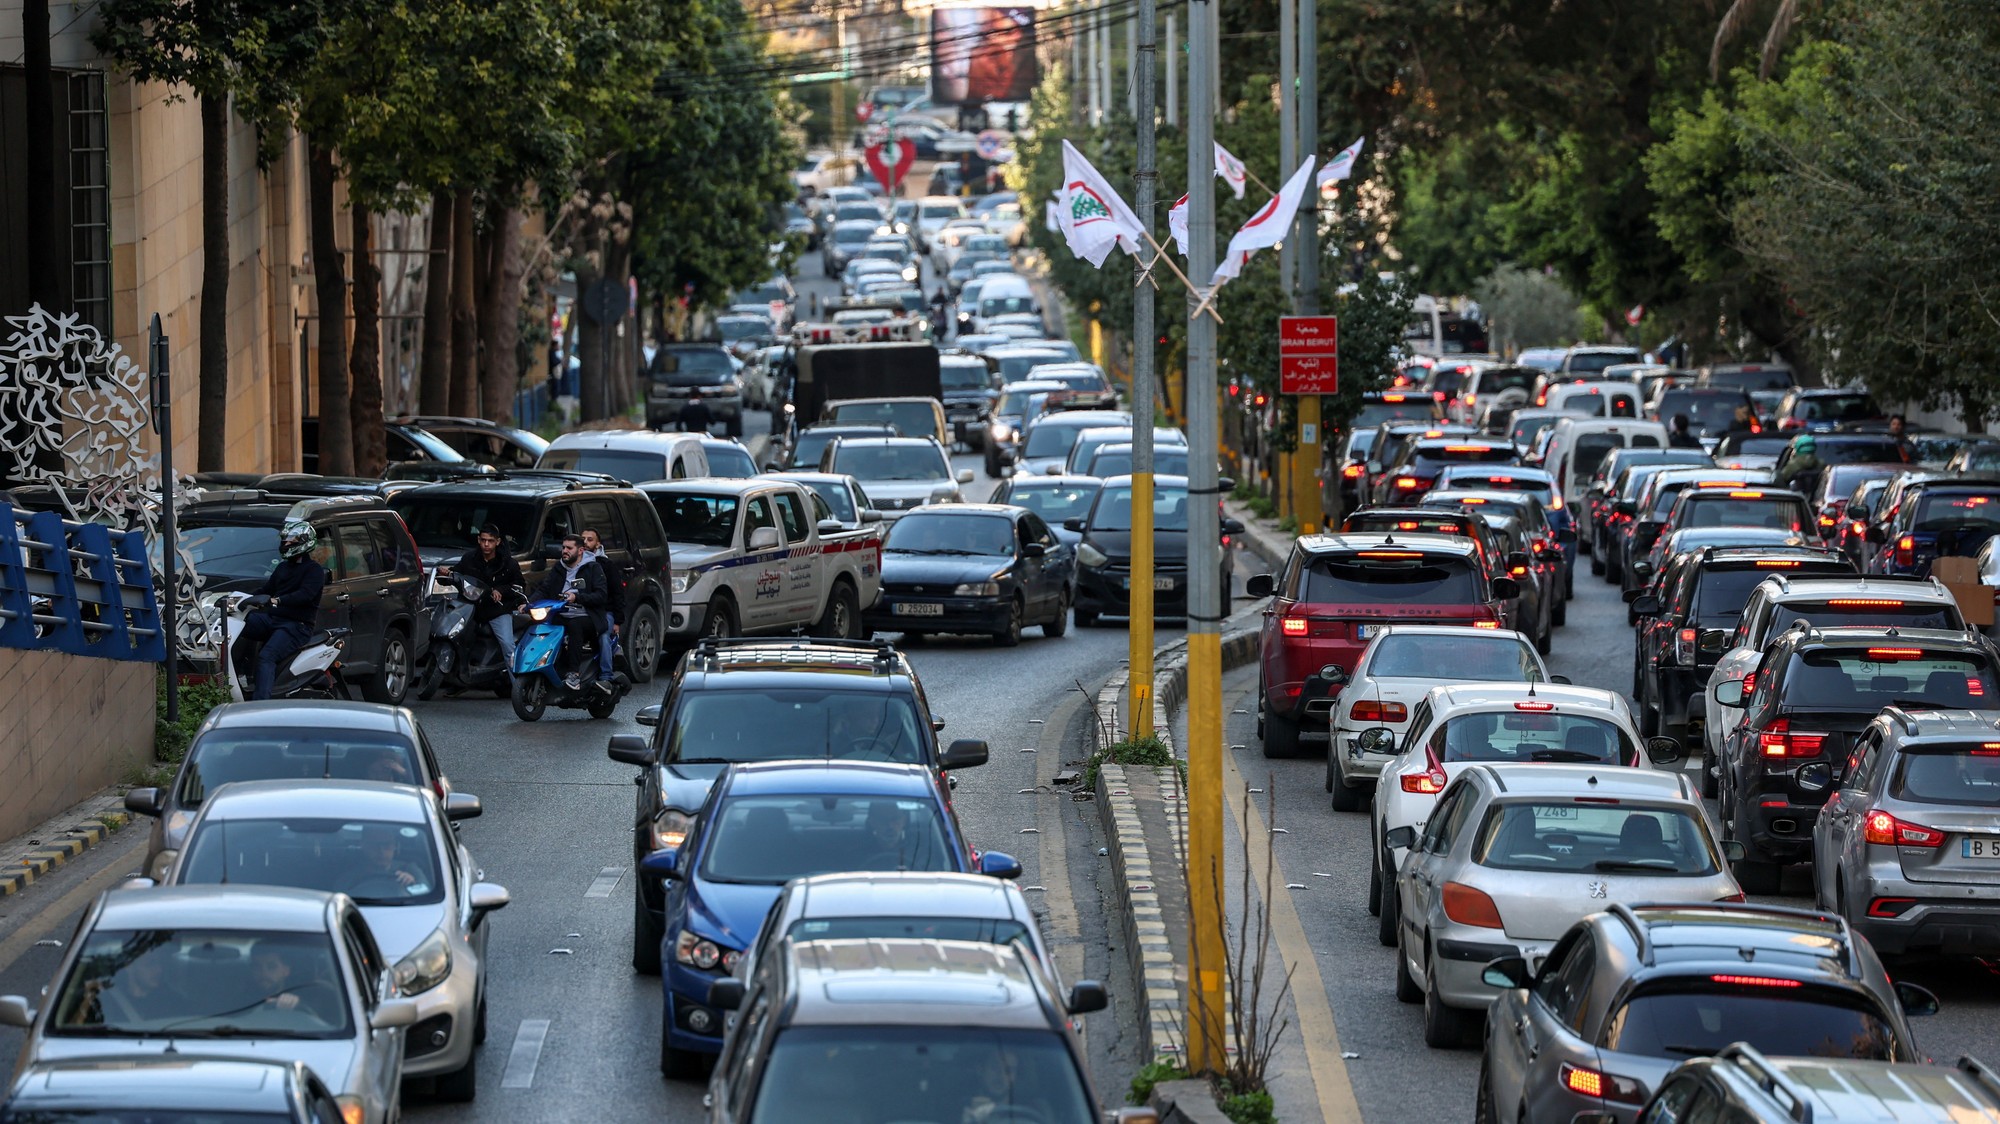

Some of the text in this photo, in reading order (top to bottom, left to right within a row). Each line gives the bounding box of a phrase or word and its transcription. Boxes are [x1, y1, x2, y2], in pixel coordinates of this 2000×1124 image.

[1280, 338, 1334, 347] BRAIN BEIRUT
[908, 604, 938, 614] 252034
[1974, 841, 1983, 855] B
